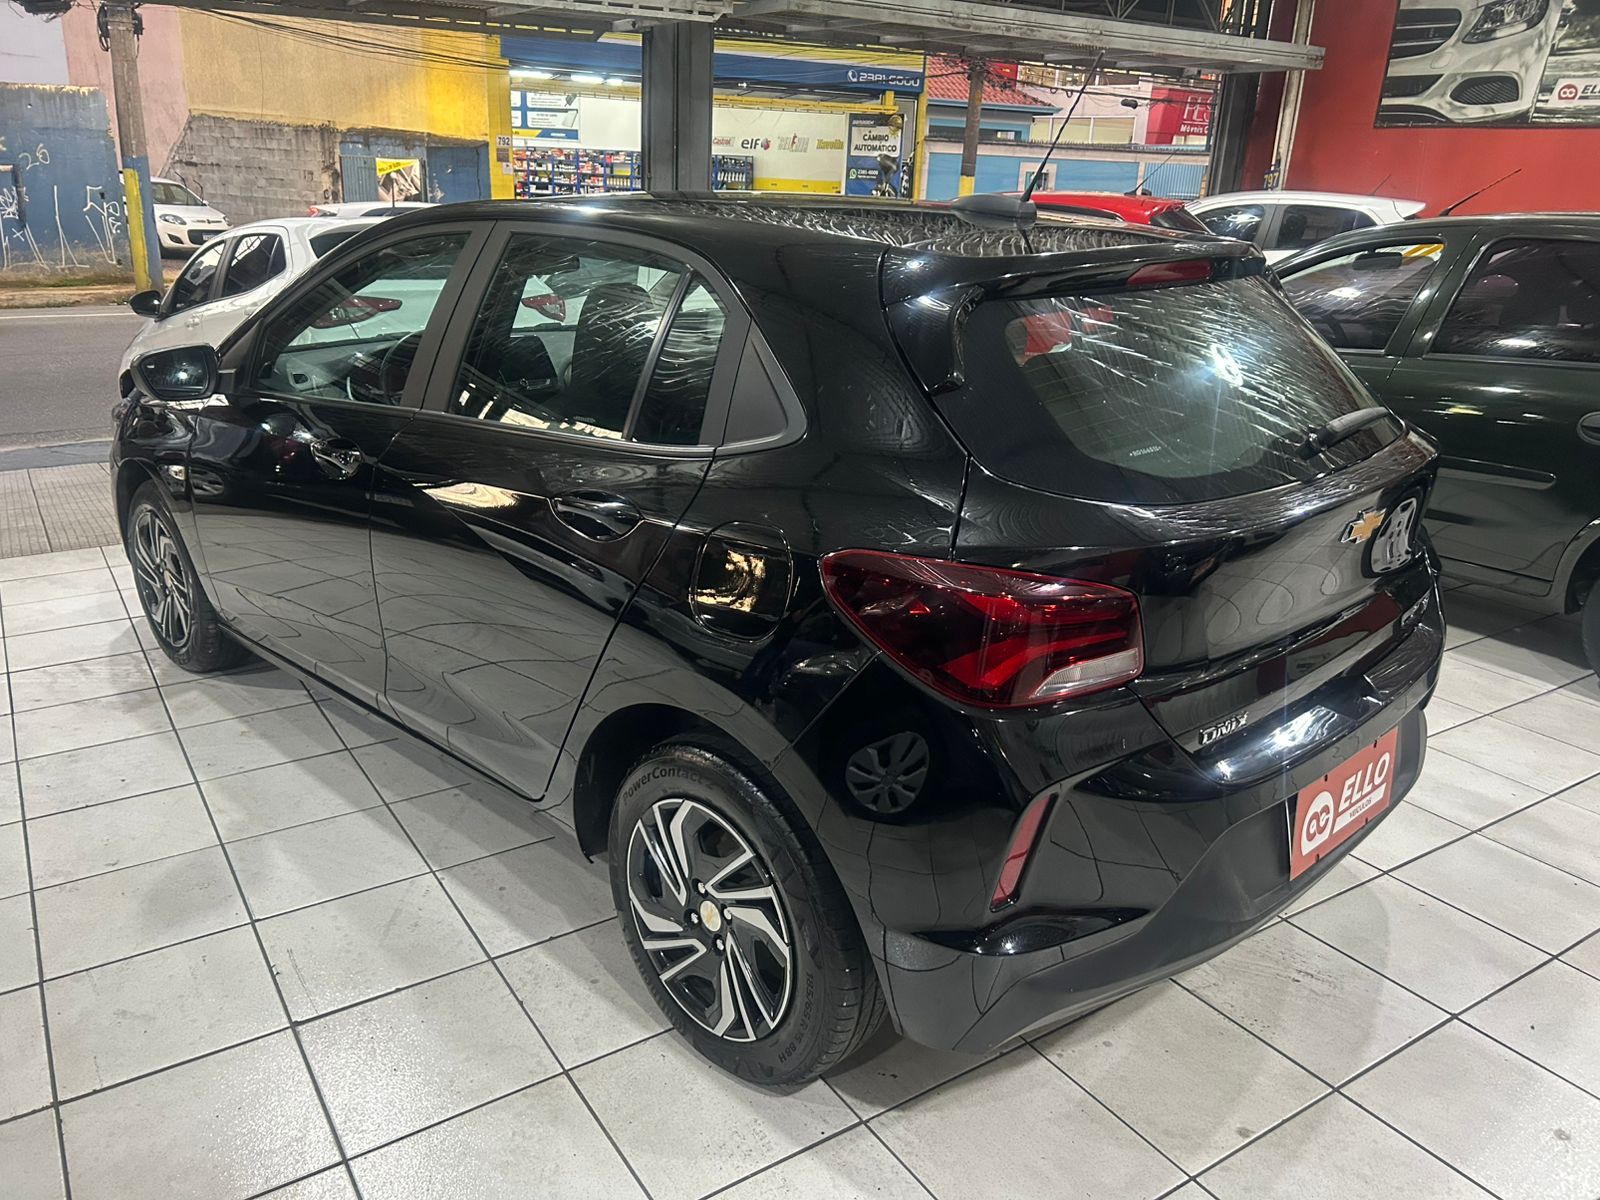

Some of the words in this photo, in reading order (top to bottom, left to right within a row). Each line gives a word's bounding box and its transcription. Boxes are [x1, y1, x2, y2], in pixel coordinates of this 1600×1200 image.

[1581, 84, 1600, 94] EL
[498, 136, 510, 146] 792
[740, 138, 760, 149] elf
[863, 130, 889, 141] CÂMBIO
[1263, 173, 1279, 189] 797
[621, 766, 704, 805] PowerContact
[1338, 752, 1390, 813] ELLO
[803, 971, 815, 1020] 185/65
[778, 1041, 797, 1063] 88H
